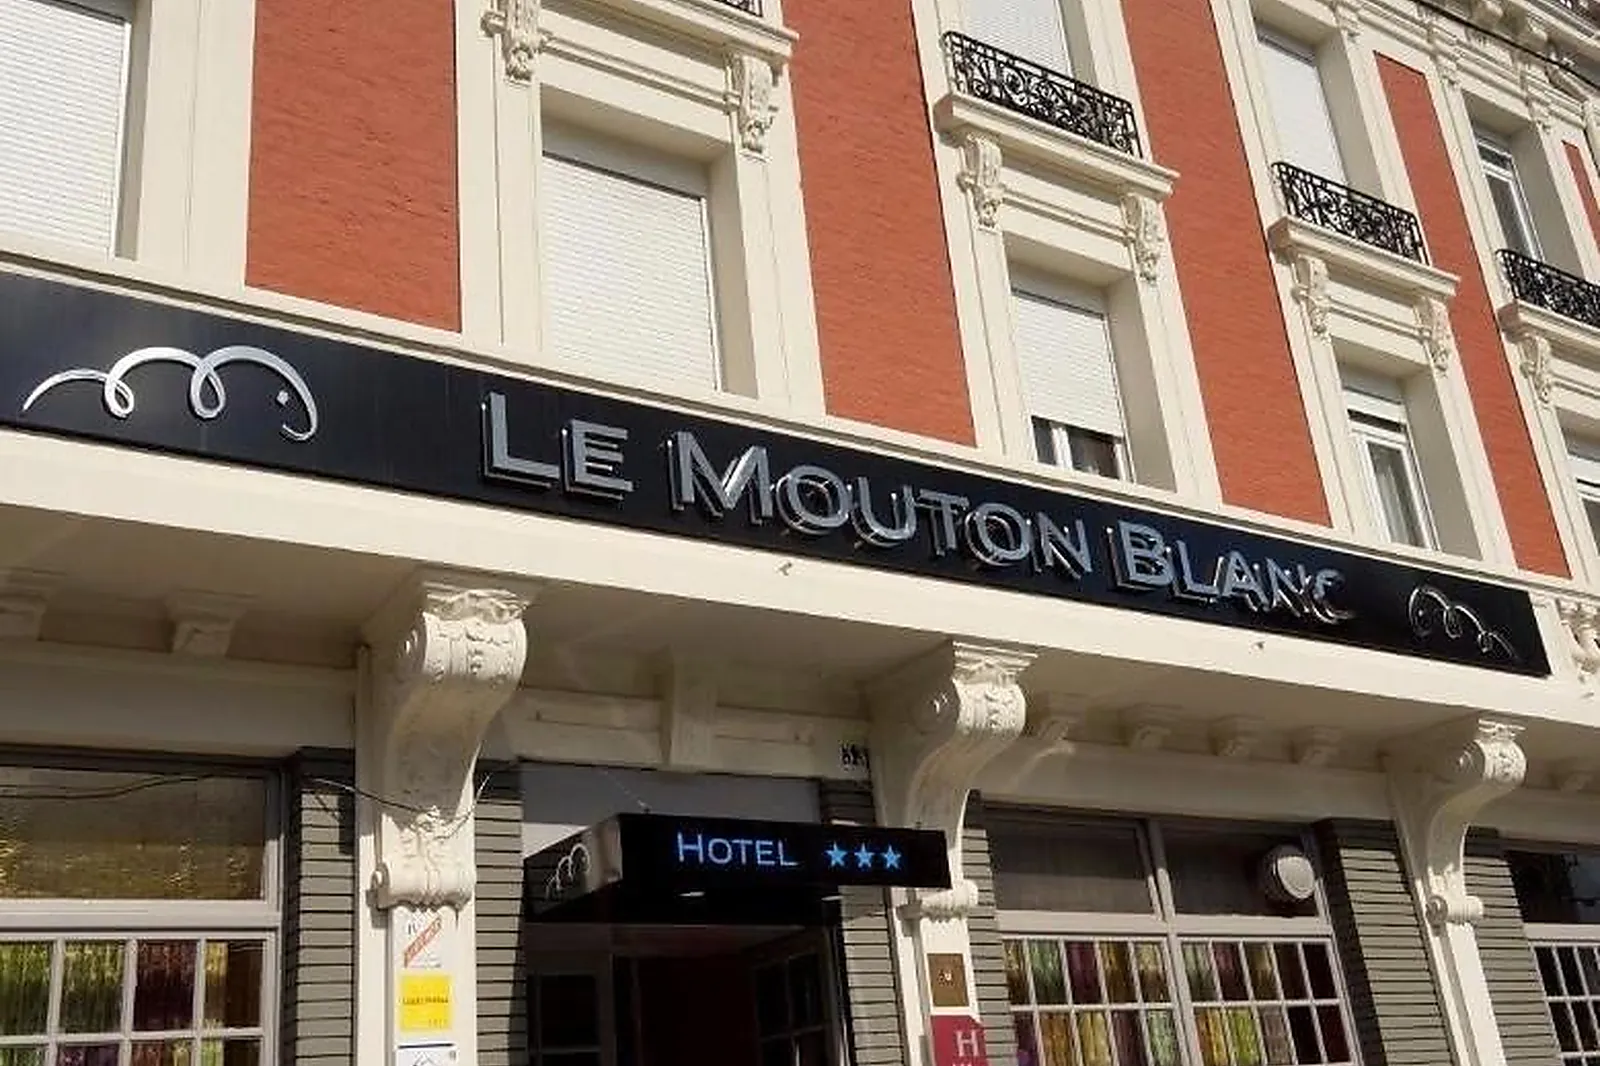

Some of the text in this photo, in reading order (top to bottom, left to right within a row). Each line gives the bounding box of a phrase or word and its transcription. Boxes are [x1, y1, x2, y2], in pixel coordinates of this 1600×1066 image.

[481, 391, 1354, 624] LE MOUTON BLANC
[677, 832, 799, 866] HOTEL
[955, 1030, 980, 1057] H
